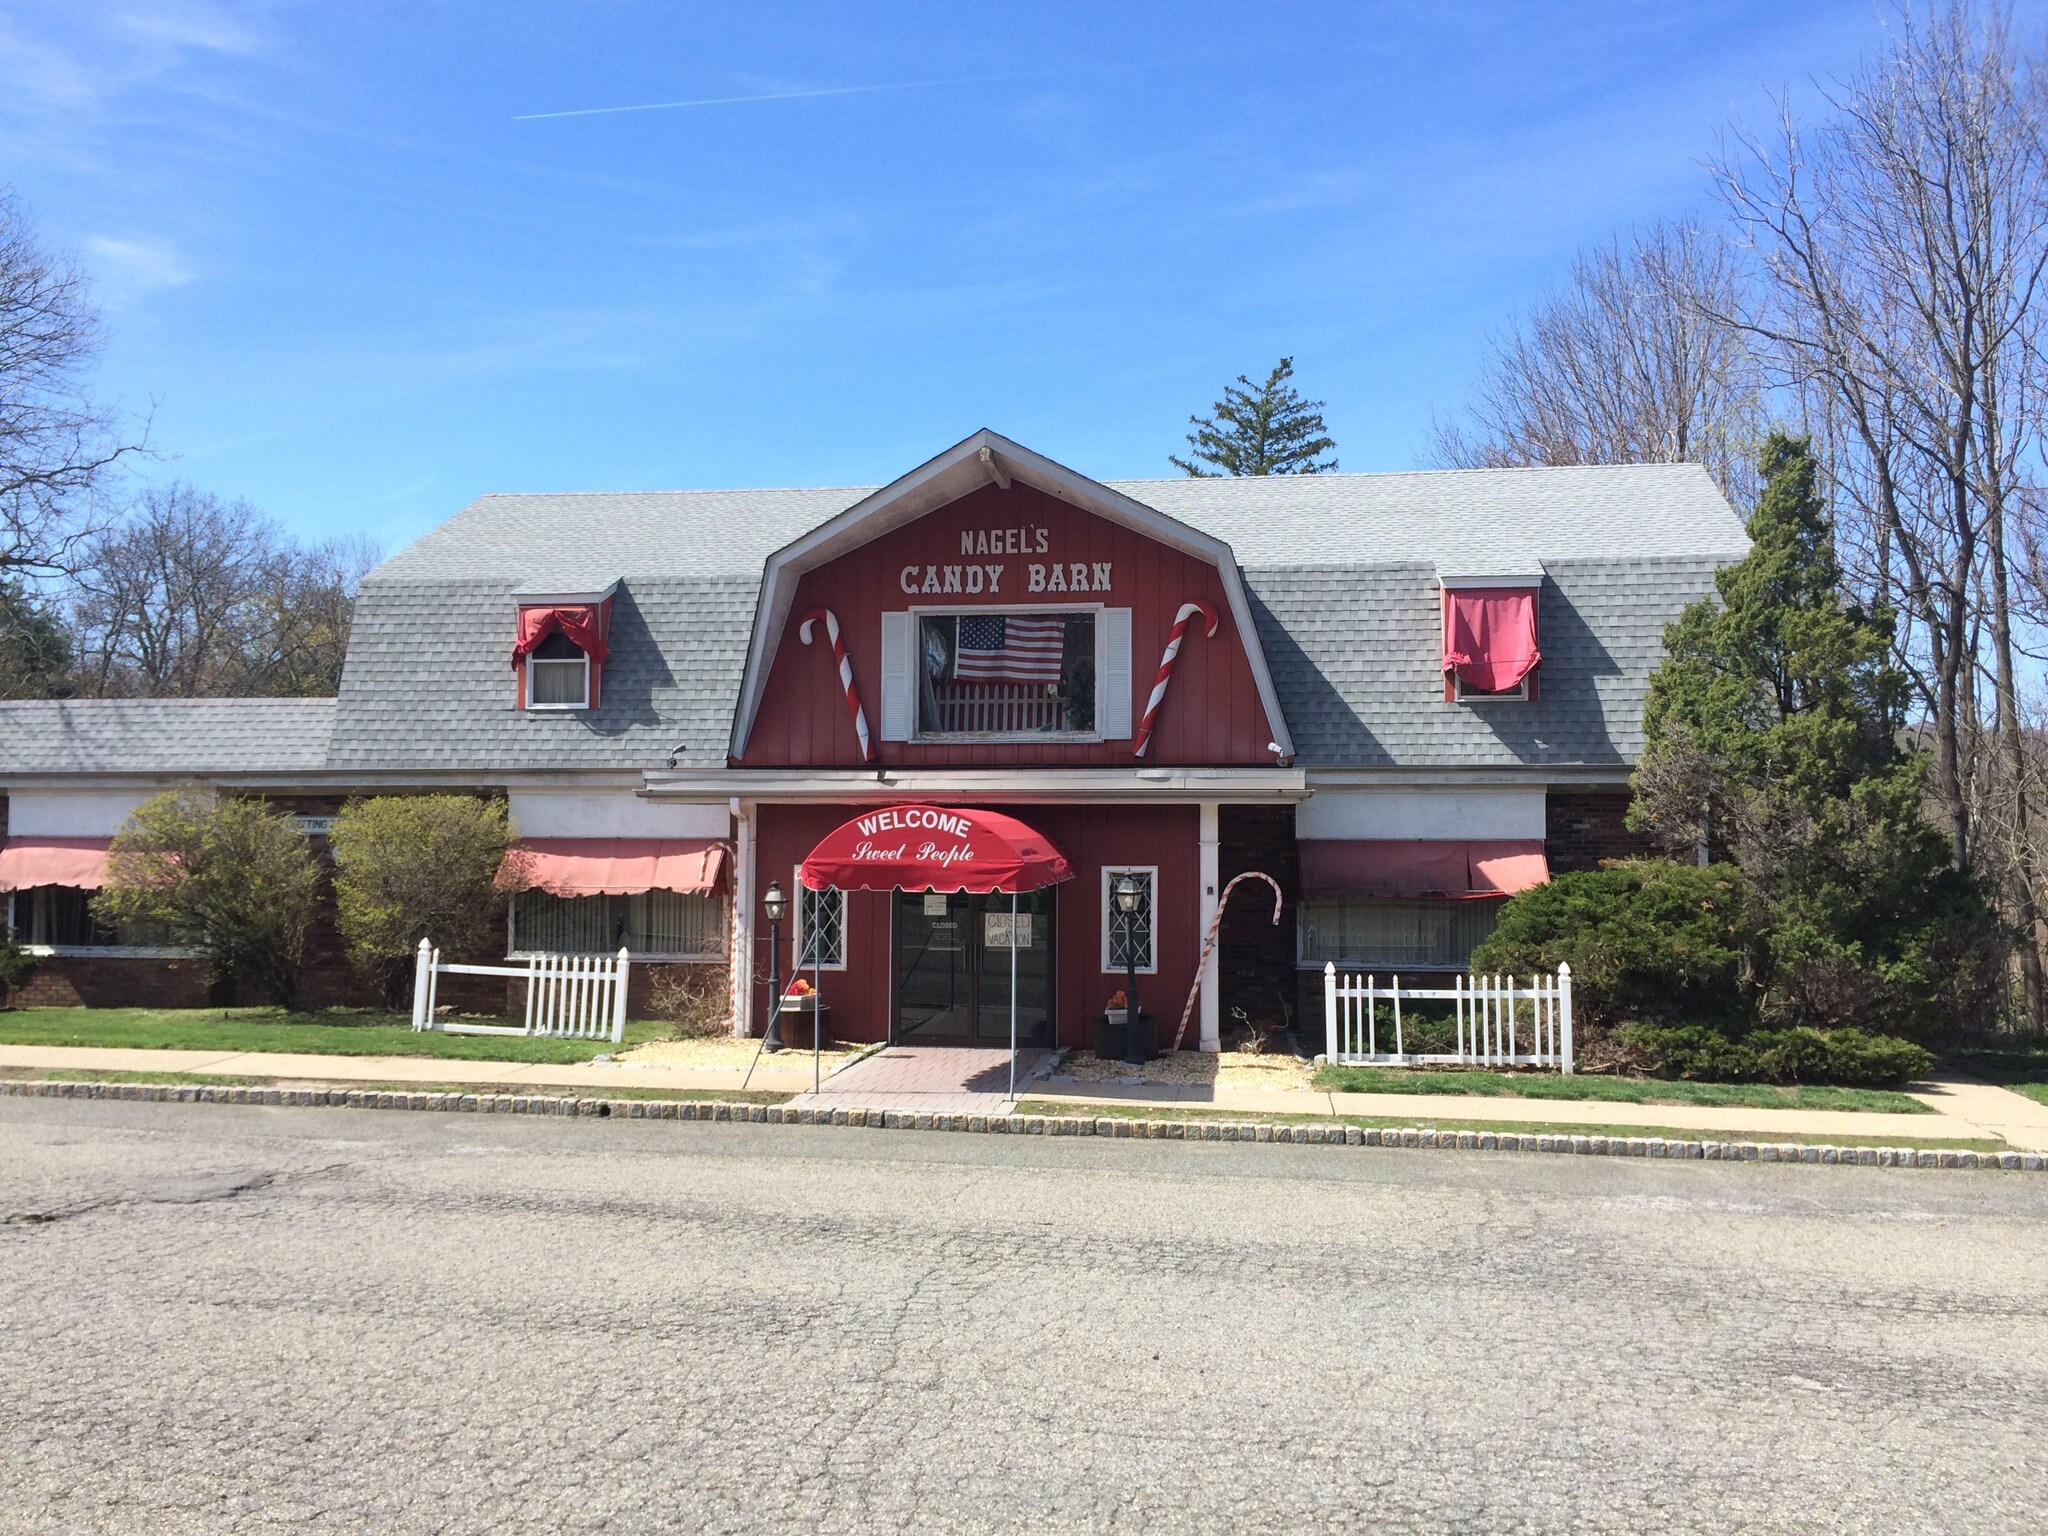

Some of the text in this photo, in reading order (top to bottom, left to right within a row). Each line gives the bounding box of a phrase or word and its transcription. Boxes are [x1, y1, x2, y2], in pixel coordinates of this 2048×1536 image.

[960, 523, 1049, 555] NAGEL'S
[900, 562, 1112, 594] CANDY BARN
[857, 810, 973, 838] WELCOME
[852, 841, 975, 868] Sweet People
[931, 921, 958, 929] CLOSED
[987, 913, 1030, 928] CLOSED
[987, 933, 1030, 945] VACAON
